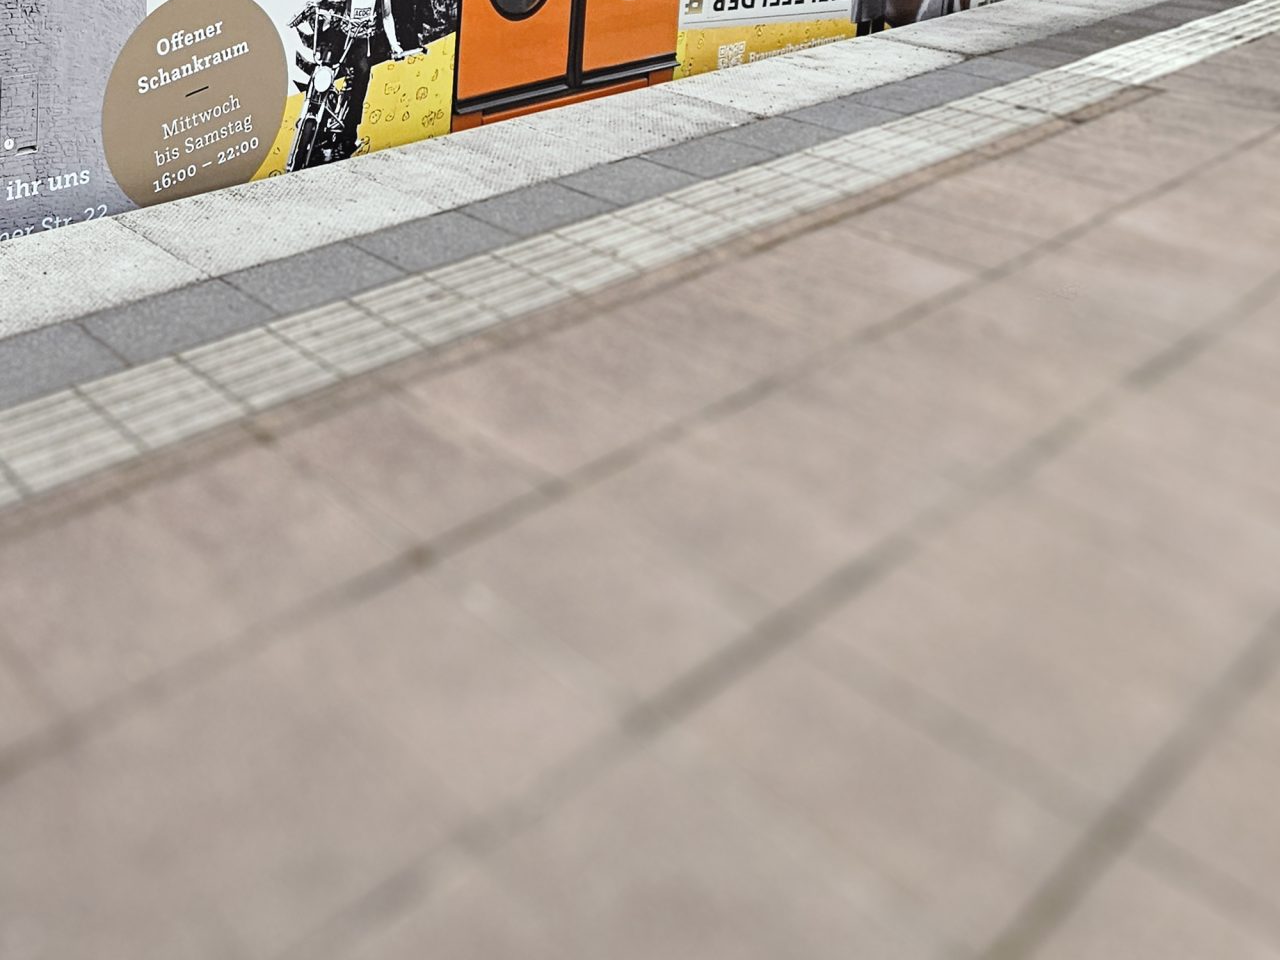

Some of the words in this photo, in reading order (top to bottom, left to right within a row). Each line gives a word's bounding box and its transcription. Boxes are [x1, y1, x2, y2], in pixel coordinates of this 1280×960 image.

[156, 21, 223, 56] Offener
[137, 41, 249, 94] Schankraum
[154, 147, 180, 167] bis
[185, 115, 253, 154] Samstag
[161, 94, 241, 140] Mittwoch
[6, 178, 45, 202] ihr
[48, 169, 91, 192] uns
[153, 164, 197, 193] 16:00
[217, 137, 259, 164] 22:00
